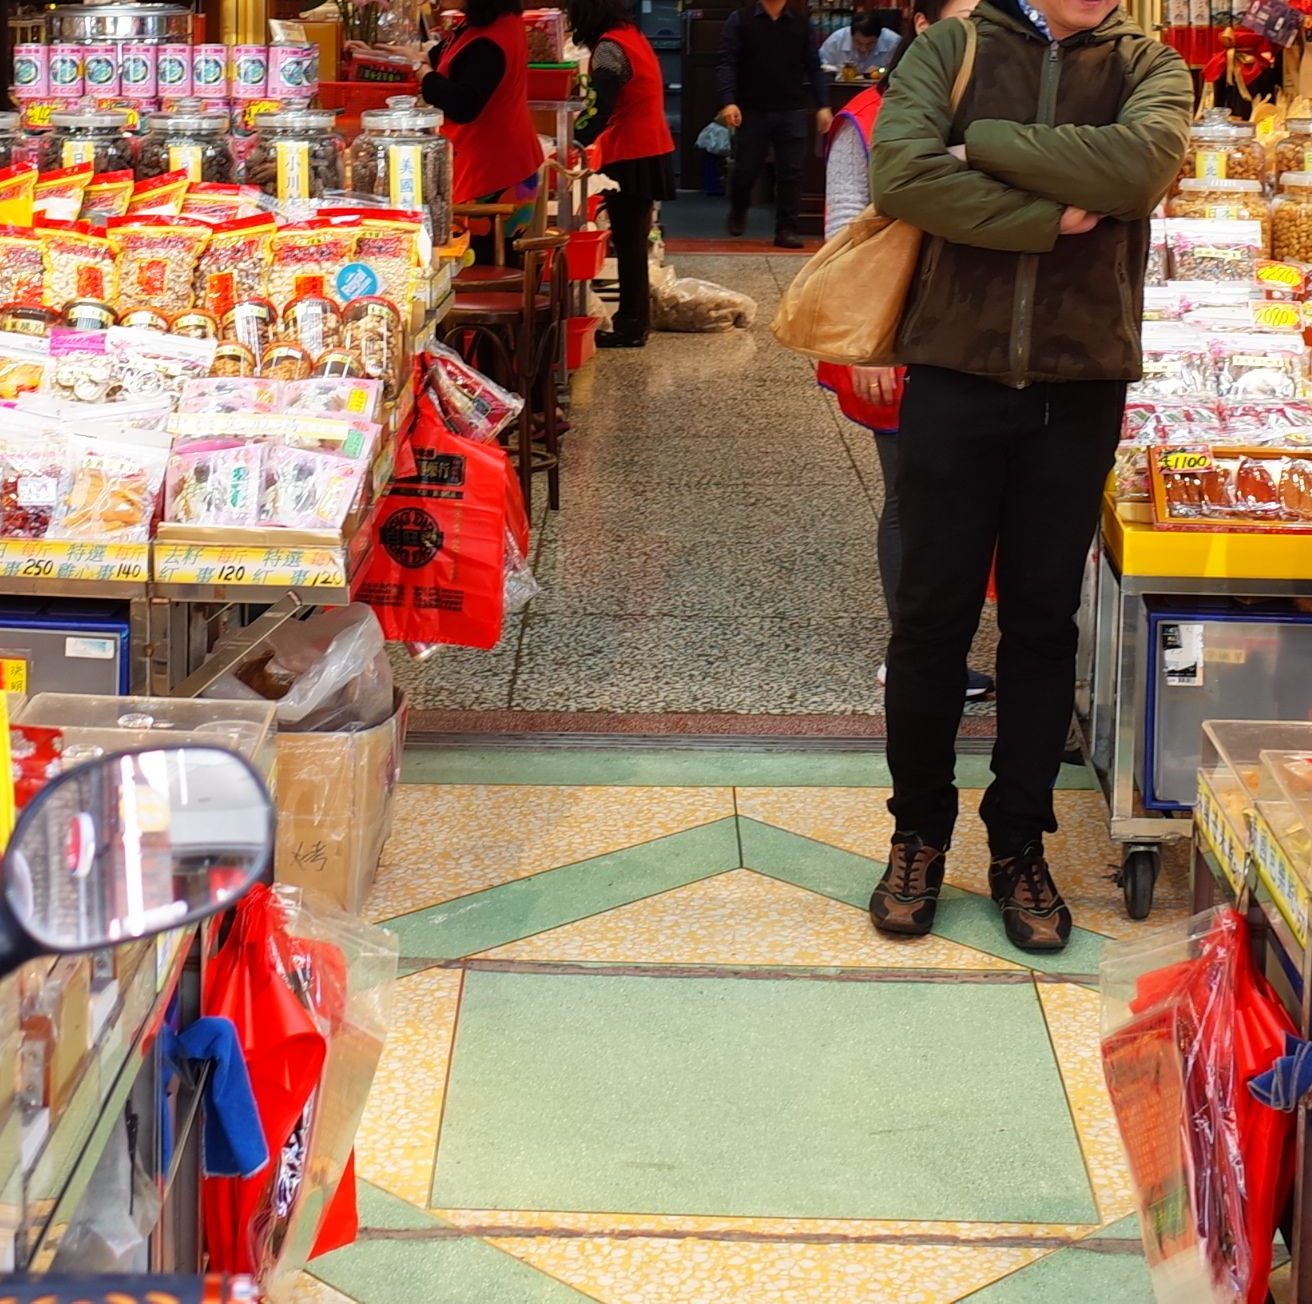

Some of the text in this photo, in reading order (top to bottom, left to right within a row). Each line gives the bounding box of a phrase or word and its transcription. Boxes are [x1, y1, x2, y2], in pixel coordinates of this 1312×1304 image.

[23, 558, 54, 576] 250
[116, 564, 142, 579] 140
[217, 565, 246, 581] 120
